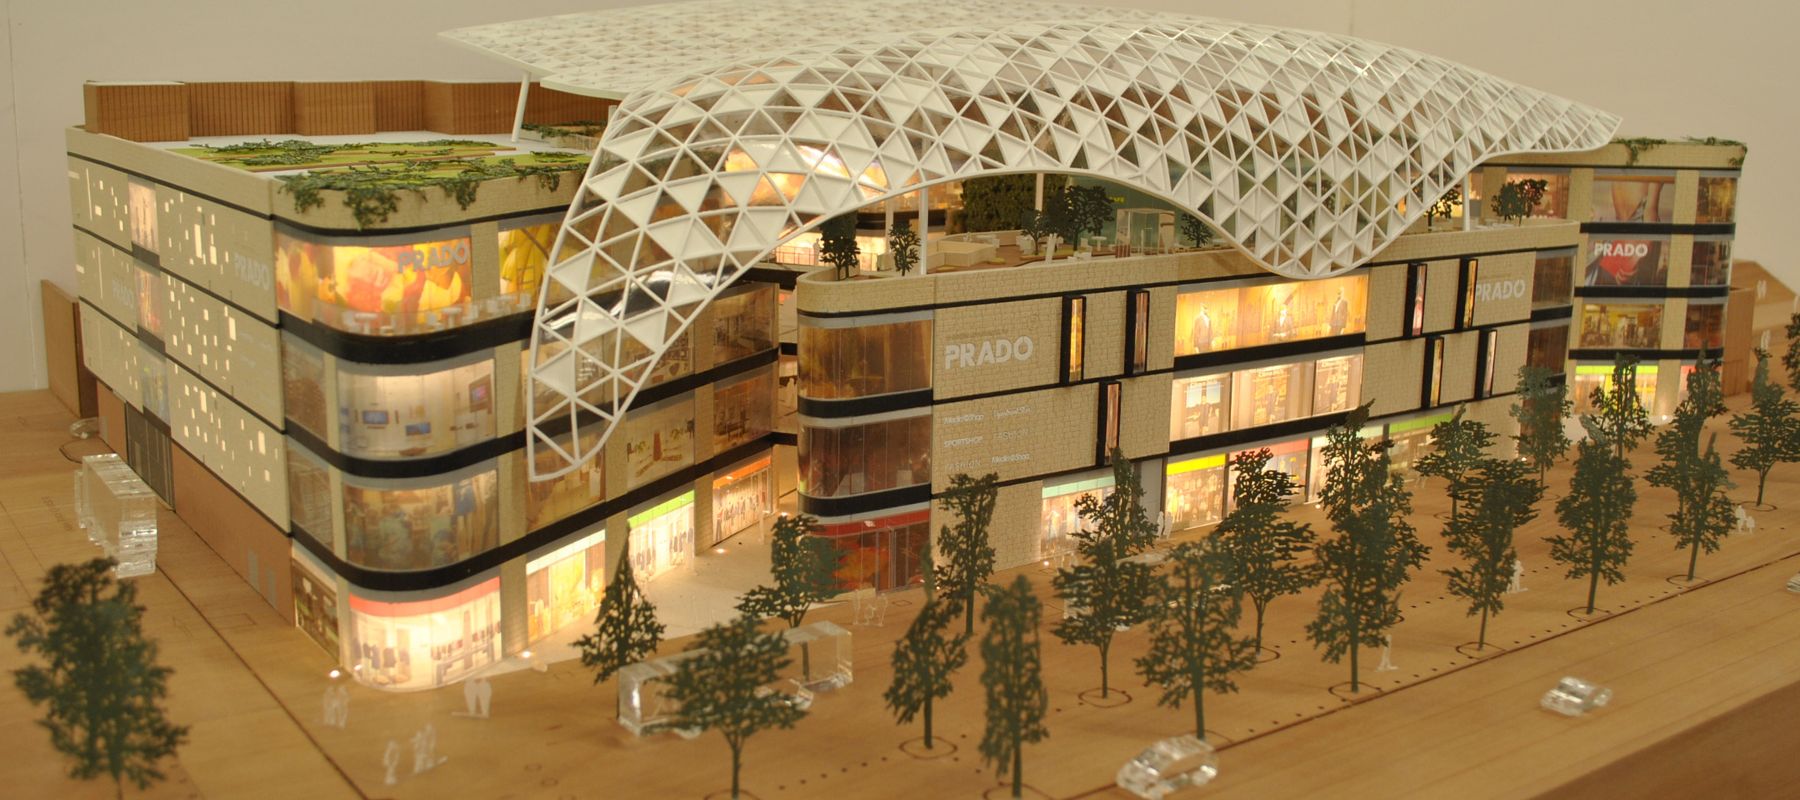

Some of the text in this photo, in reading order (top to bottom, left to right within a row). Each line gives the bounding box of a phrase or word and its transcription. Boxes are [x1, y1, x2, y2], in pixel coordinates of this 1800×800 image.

[397, 242, 470, 274] PRADO
[1593, 242, 1648, 257] PRADO
[233, 251, 270, 291] PRADO
[1474, 279, 1525, 303] PRADO
[945, 335, 1033, 369] PRADO
